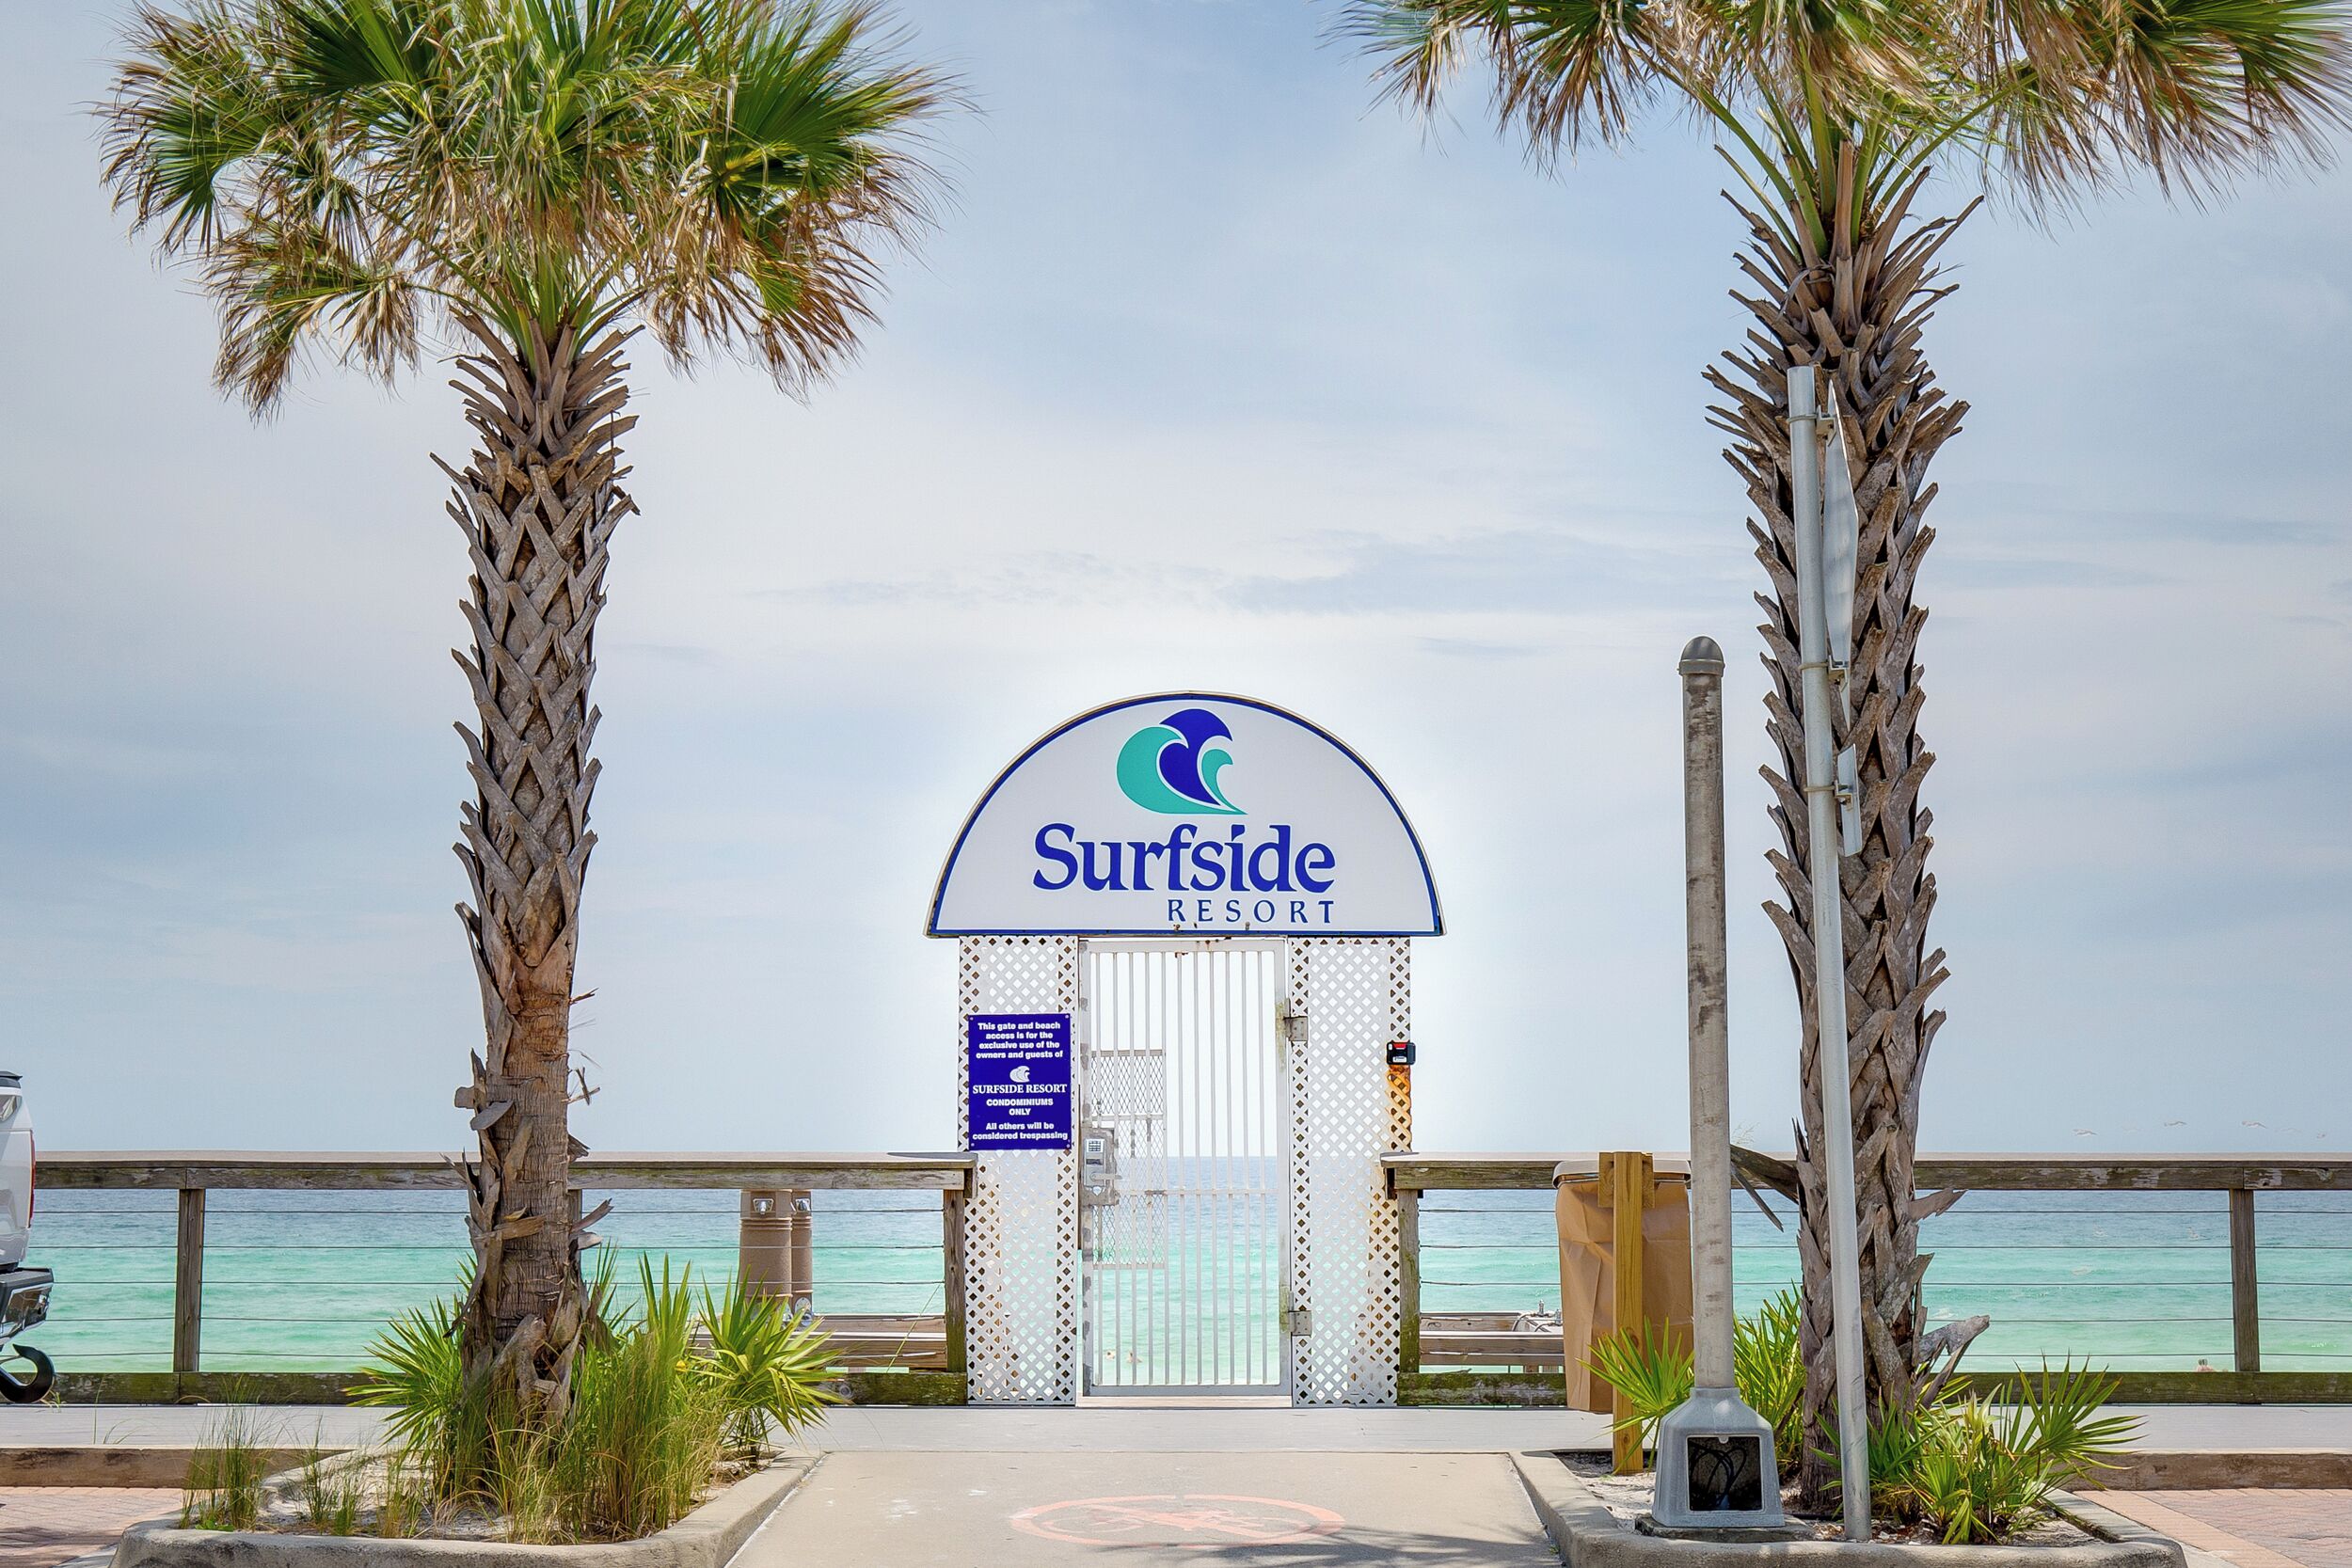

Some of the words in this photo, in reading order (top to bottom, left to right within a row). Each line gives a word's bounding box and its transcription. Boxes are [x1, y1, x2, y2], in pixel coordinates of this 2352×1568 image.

[1033, 822, 1336, 893] Surfside
[1168, 898, 1333, 924] RESORT
[997, 1022, 1016, 1031] gate
[1025, 1051, 1053, 1059] guests
[973, 1085, 1024, 1094] SURFSIDE
[1026, 1084, 1067, 1093] RESORT
[1020, 1132, 1069, 1141] trespassing
